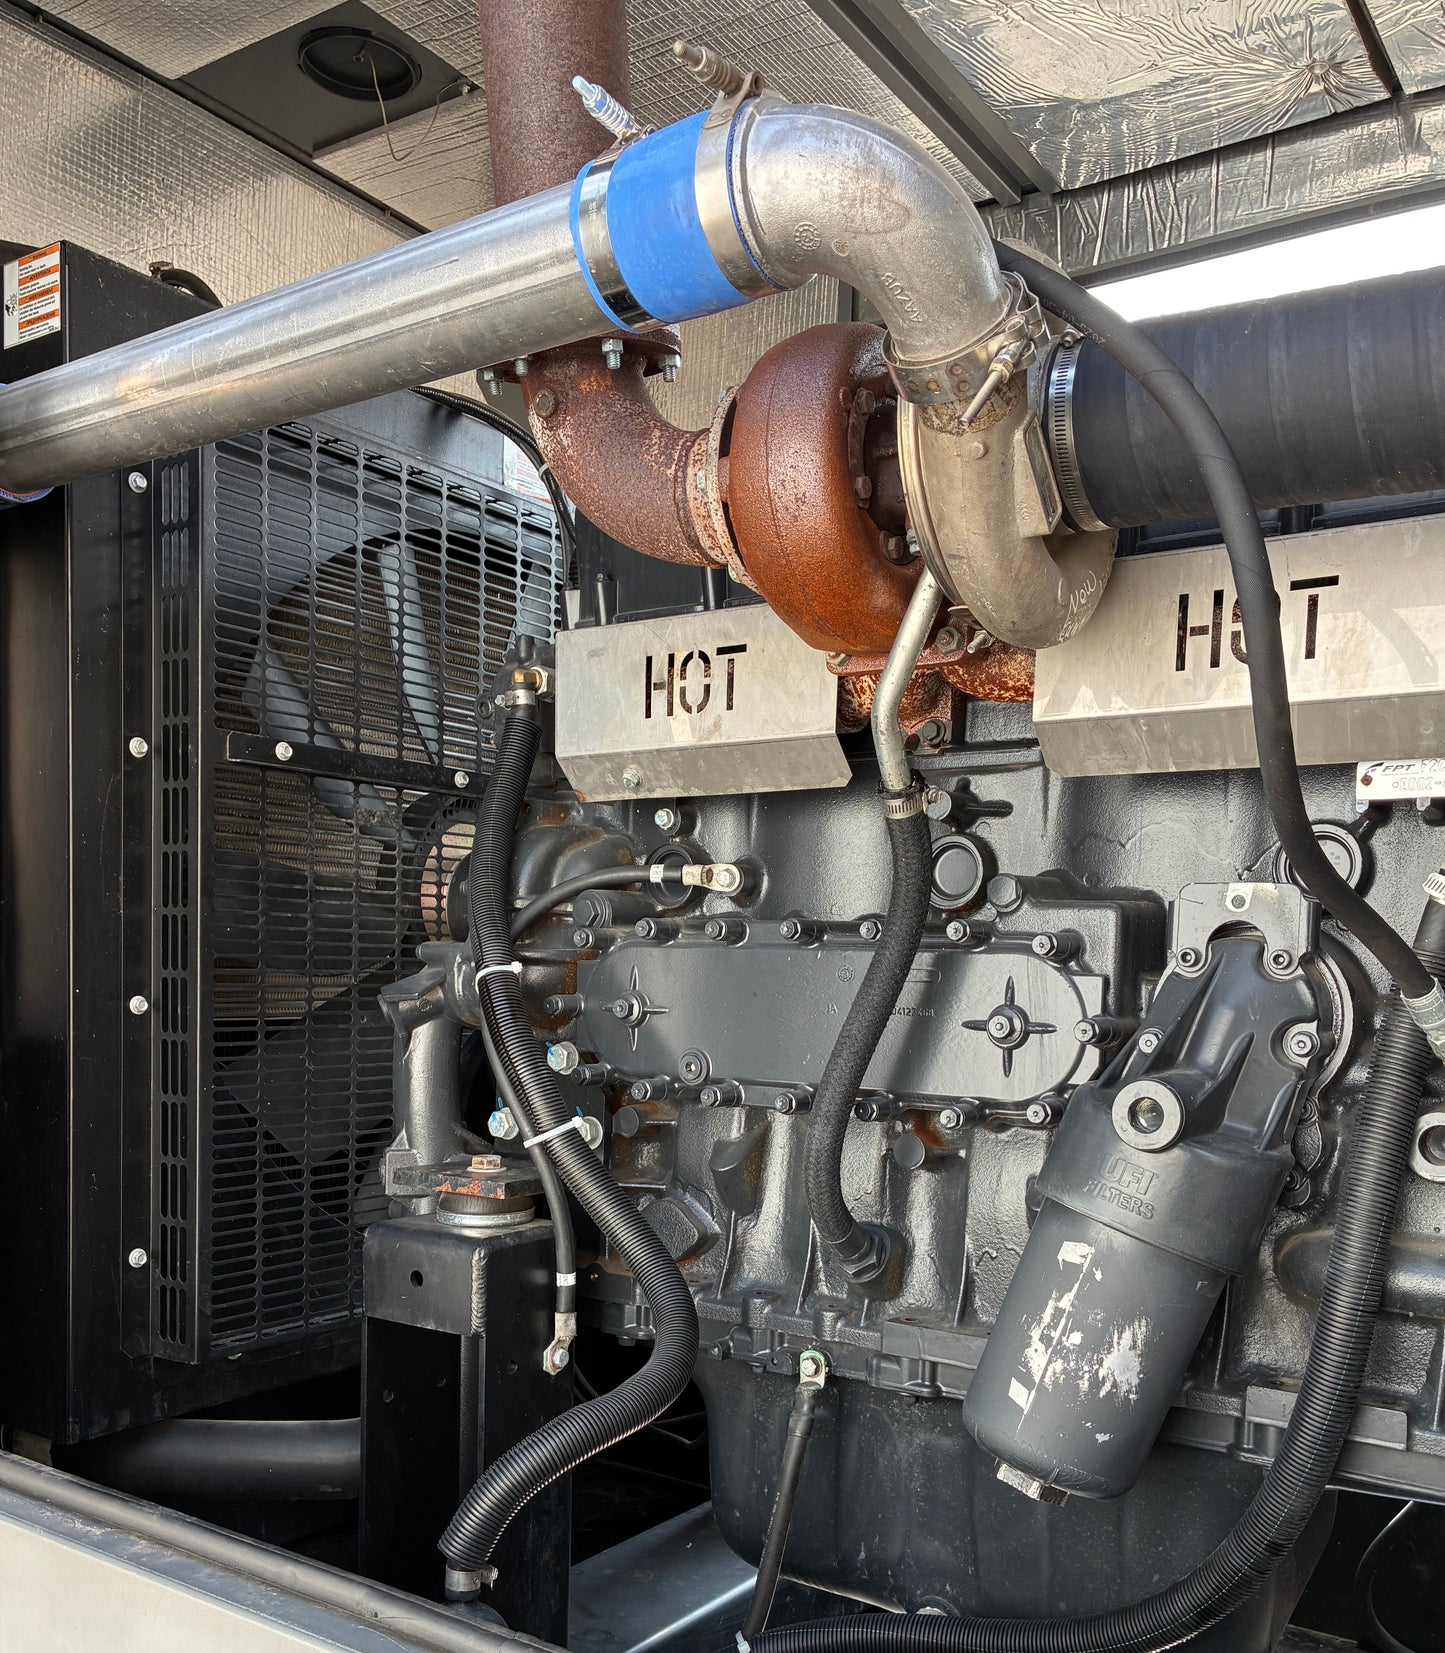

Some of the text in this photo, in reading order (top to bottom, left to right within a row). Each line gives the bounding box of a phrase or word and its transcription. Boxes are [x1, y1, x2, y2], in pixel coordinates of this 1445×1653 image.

[645, 643, 747, 719] HOT
[1382, 764, 1416, 772] FPT
[1100, 1153, 1155, 1195] UFI
[1081, 1179, 1155, 1219] FILTERS
